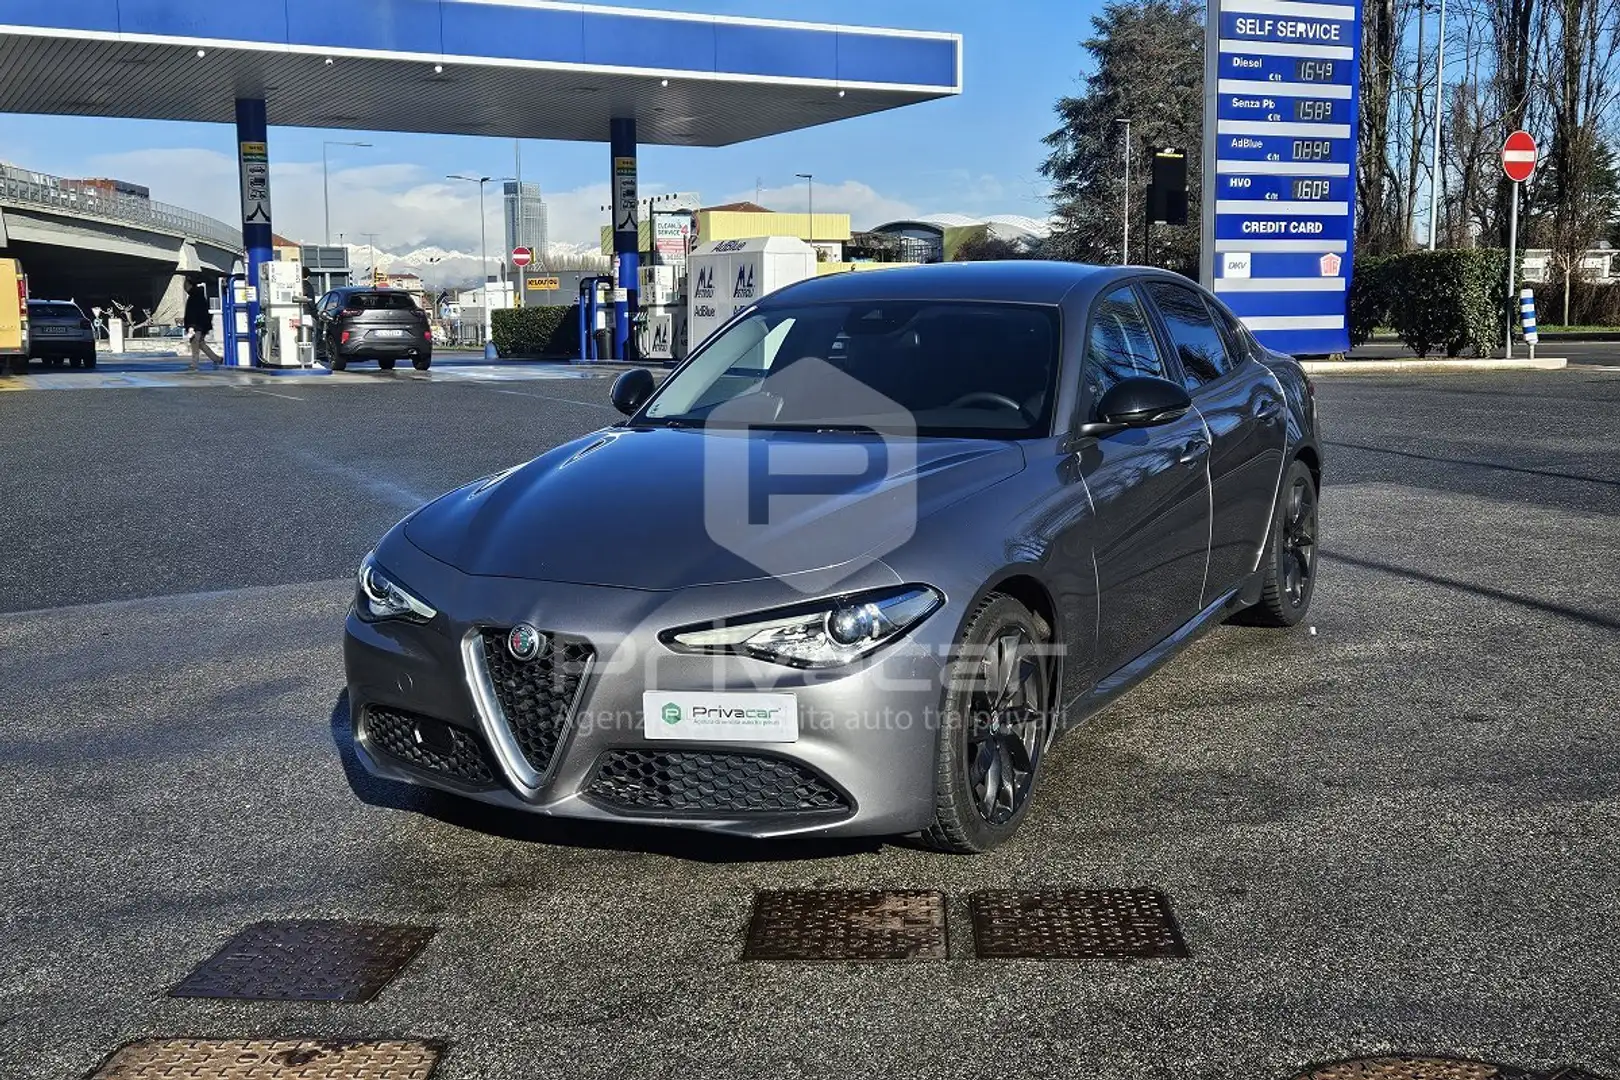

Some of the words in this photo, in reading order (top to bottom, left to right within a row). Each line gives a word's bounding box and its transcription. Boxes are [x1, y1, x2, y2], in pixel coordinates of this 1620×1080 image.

[1236, 17, 1273, 36] SELF
[1277, 20, 1340, 40] SERVICE
[1232, 57, 1262, 68] Diesel
[1232, 97, 1260, 108] Senza
[1262, 98, 1275, 109] Pb
[1231, 137, 1263, 148] AdBlue
[1229, 177, 1251, 188] HVO
[1242, 221, 1287, 233] CREDIT
[1289, 221, 1323, 234] CARD
[710, 240, 747, 253] AdBlue
[1227, 261, 1247, 270] DKV
[694, 304, 715, 317] AdBlue
[692, 705, 779, 718] Privacar
